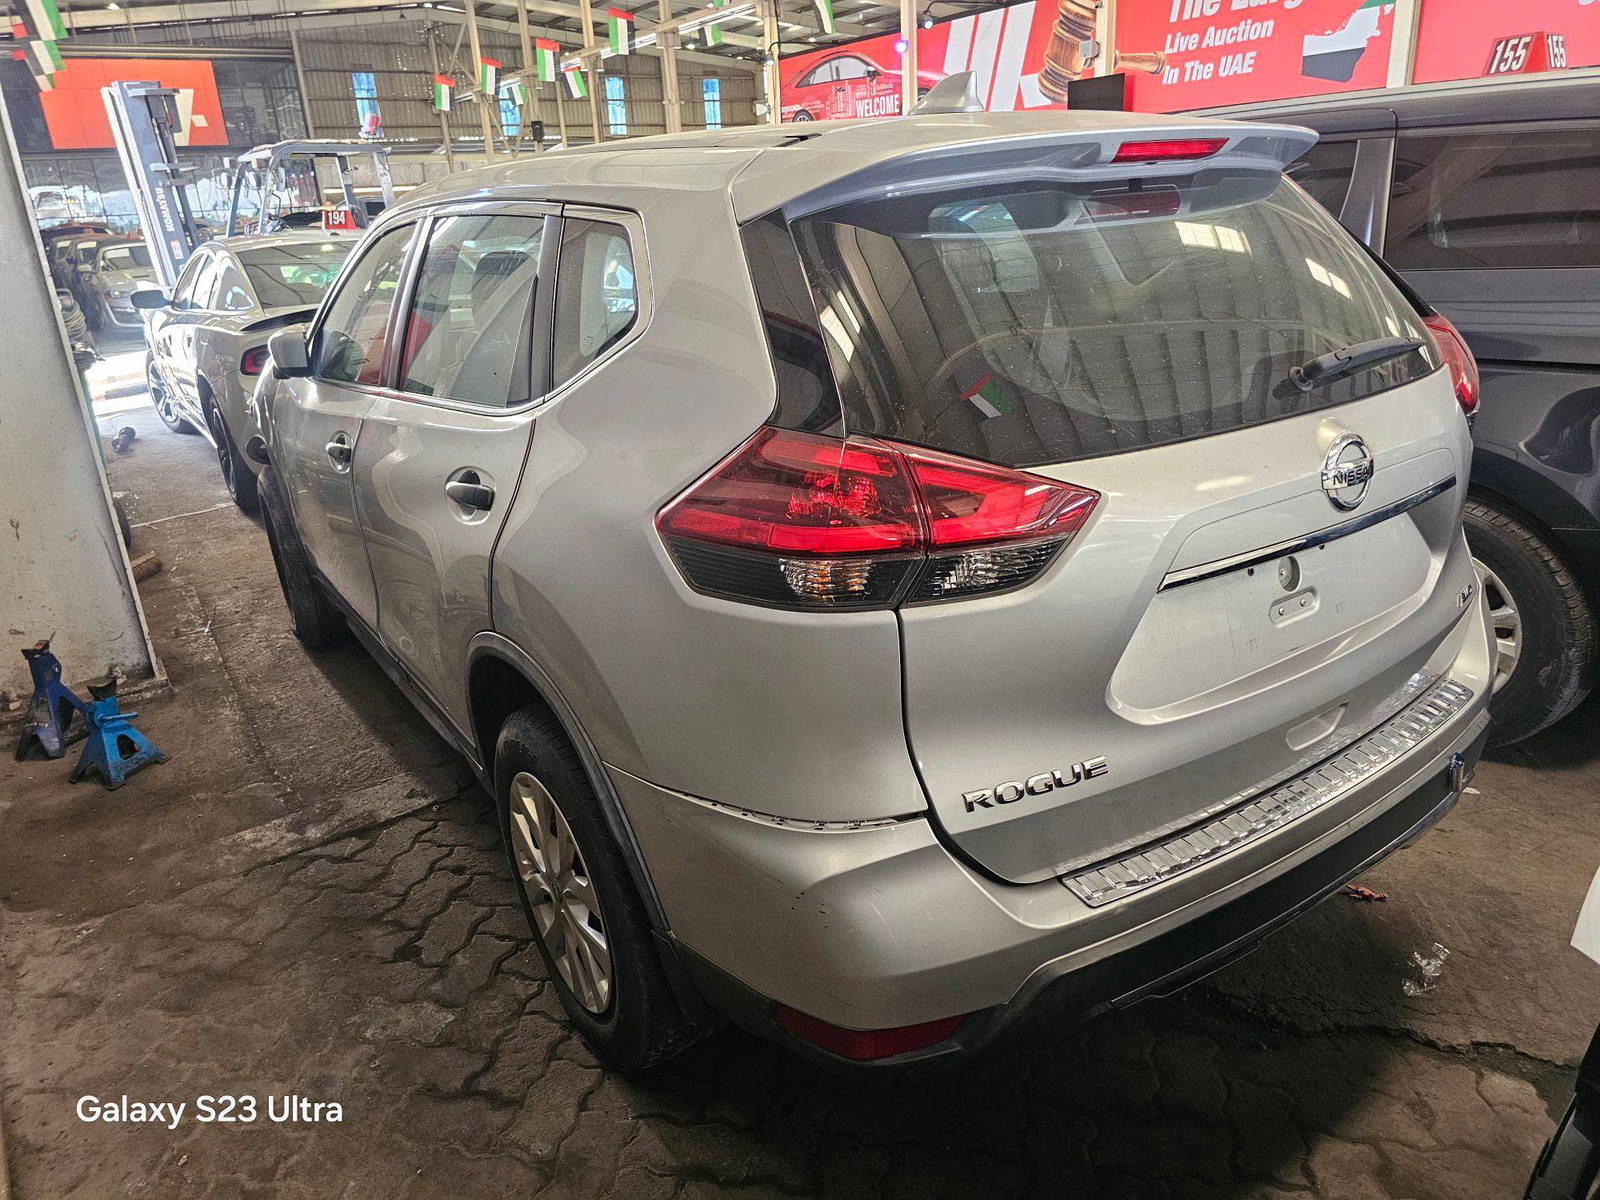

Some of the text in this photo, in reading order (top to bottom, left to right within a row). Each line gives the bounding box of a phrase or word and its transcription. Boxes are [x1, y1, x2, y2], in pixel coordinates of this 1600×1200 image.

[1164, 19, 1275, 54] Live Auction
[1547, 35, 1567, 68] 155
[1162, 51, 1257, 85] In The UAE
[1489, 36, 1532, 74] 155
[855, 94, 900, 118] WELCOME
[155, 187, 175, 232] KOMATSU
[327, 211, 346, 225] 194
[961, 755, 1109, 813] ROGUE
